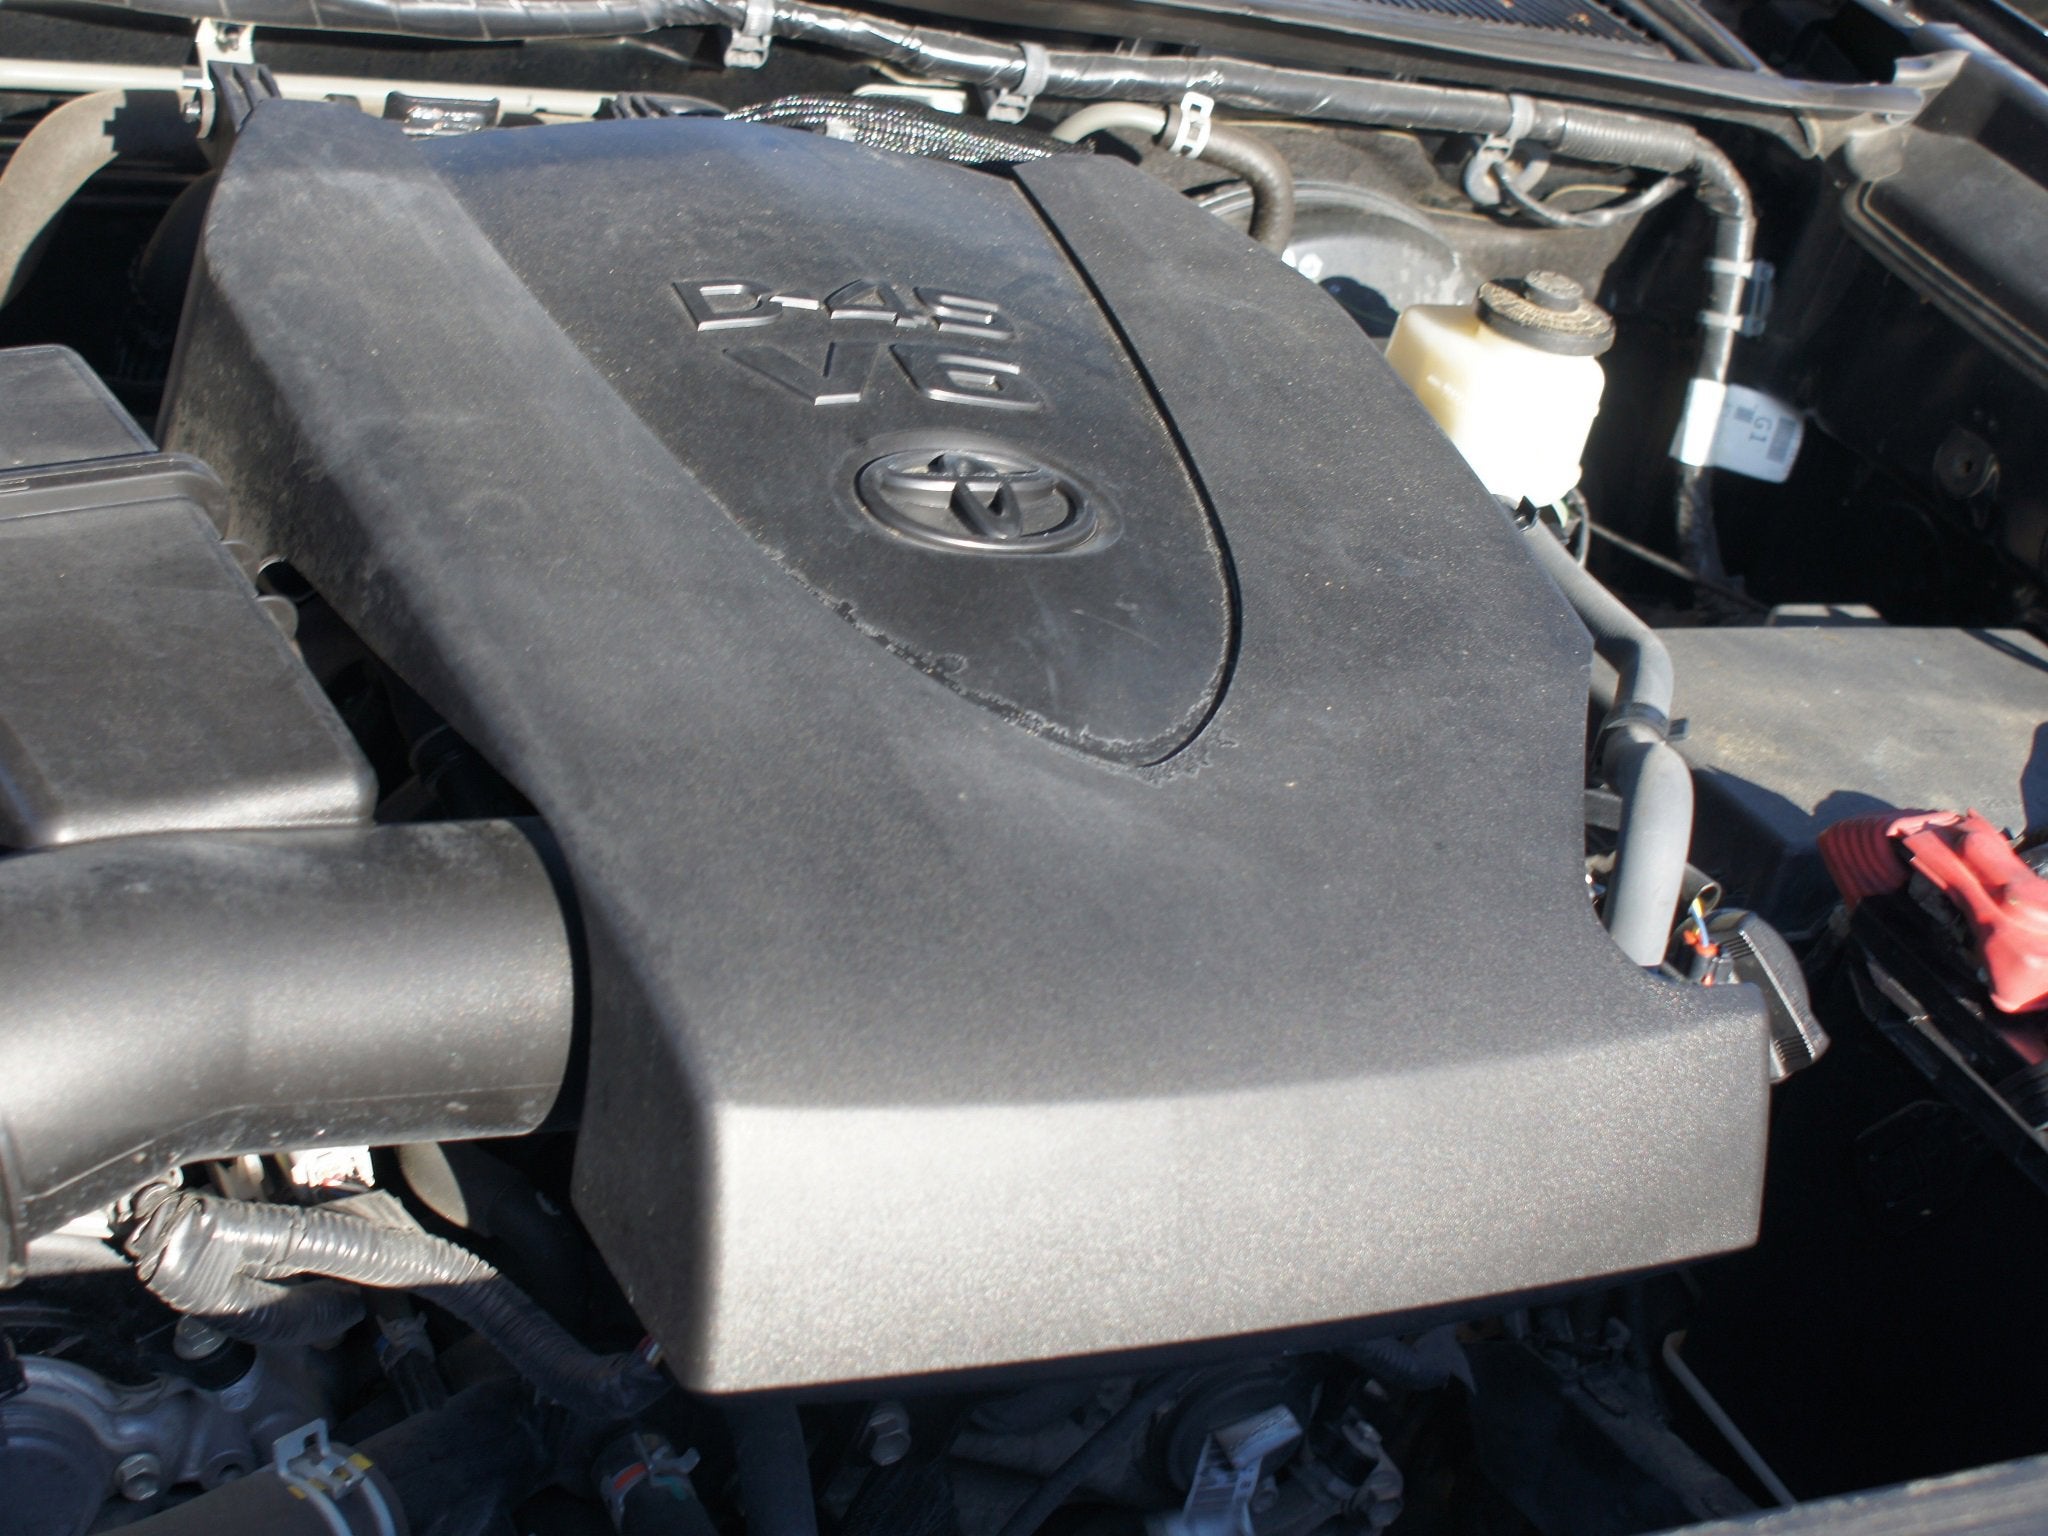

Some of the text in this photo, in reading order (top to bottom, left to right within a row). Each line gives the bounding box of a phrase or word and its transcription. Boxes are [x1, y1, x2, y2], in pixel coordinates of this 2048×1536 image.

[671, 279, 1015, 340] D-4S
[722, 341, 1048, 411] V6
[1749, 416, 1773, 443] G1
